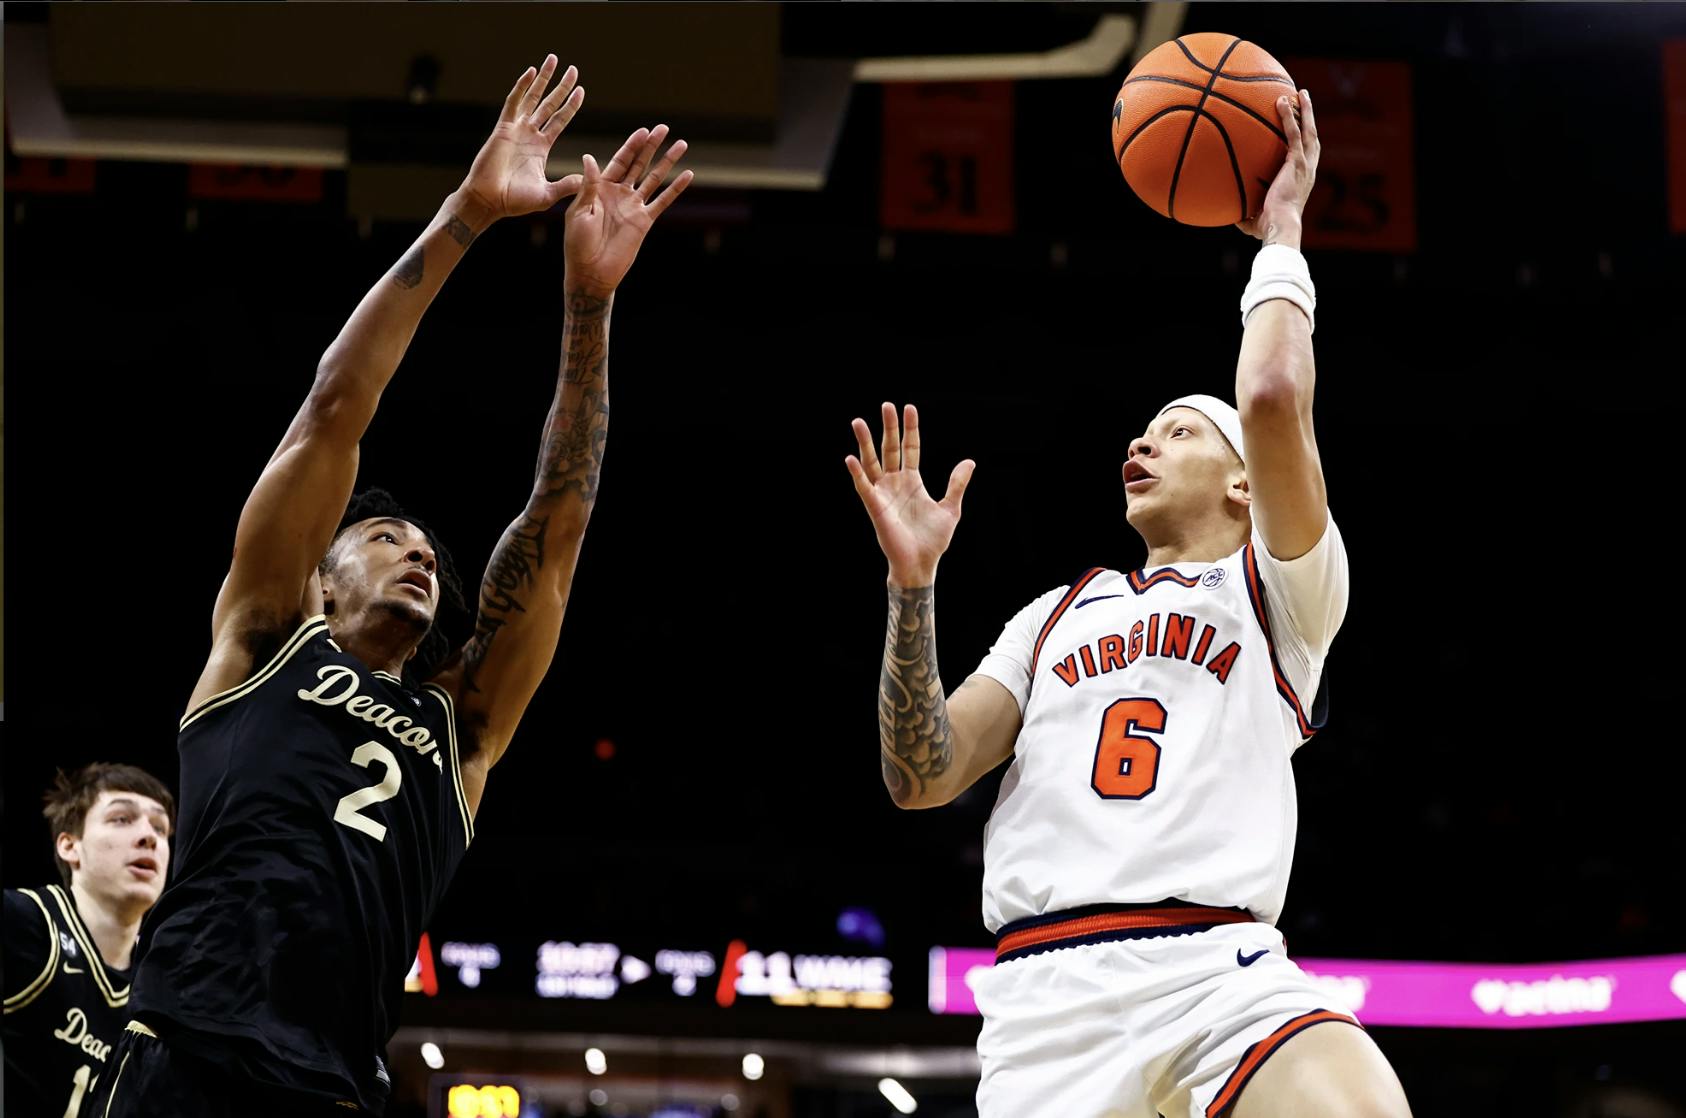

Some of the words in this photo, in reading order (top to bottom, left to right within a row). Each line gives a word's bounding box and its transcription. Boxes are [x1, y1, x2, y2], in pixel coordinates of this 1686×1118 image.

[911, 147, 979, 217] 31
[1052, 613, 1242, 687] VIRGINIA
[333, 740, 402, 843] 2
[1091, 697, 1168, 801] 6
